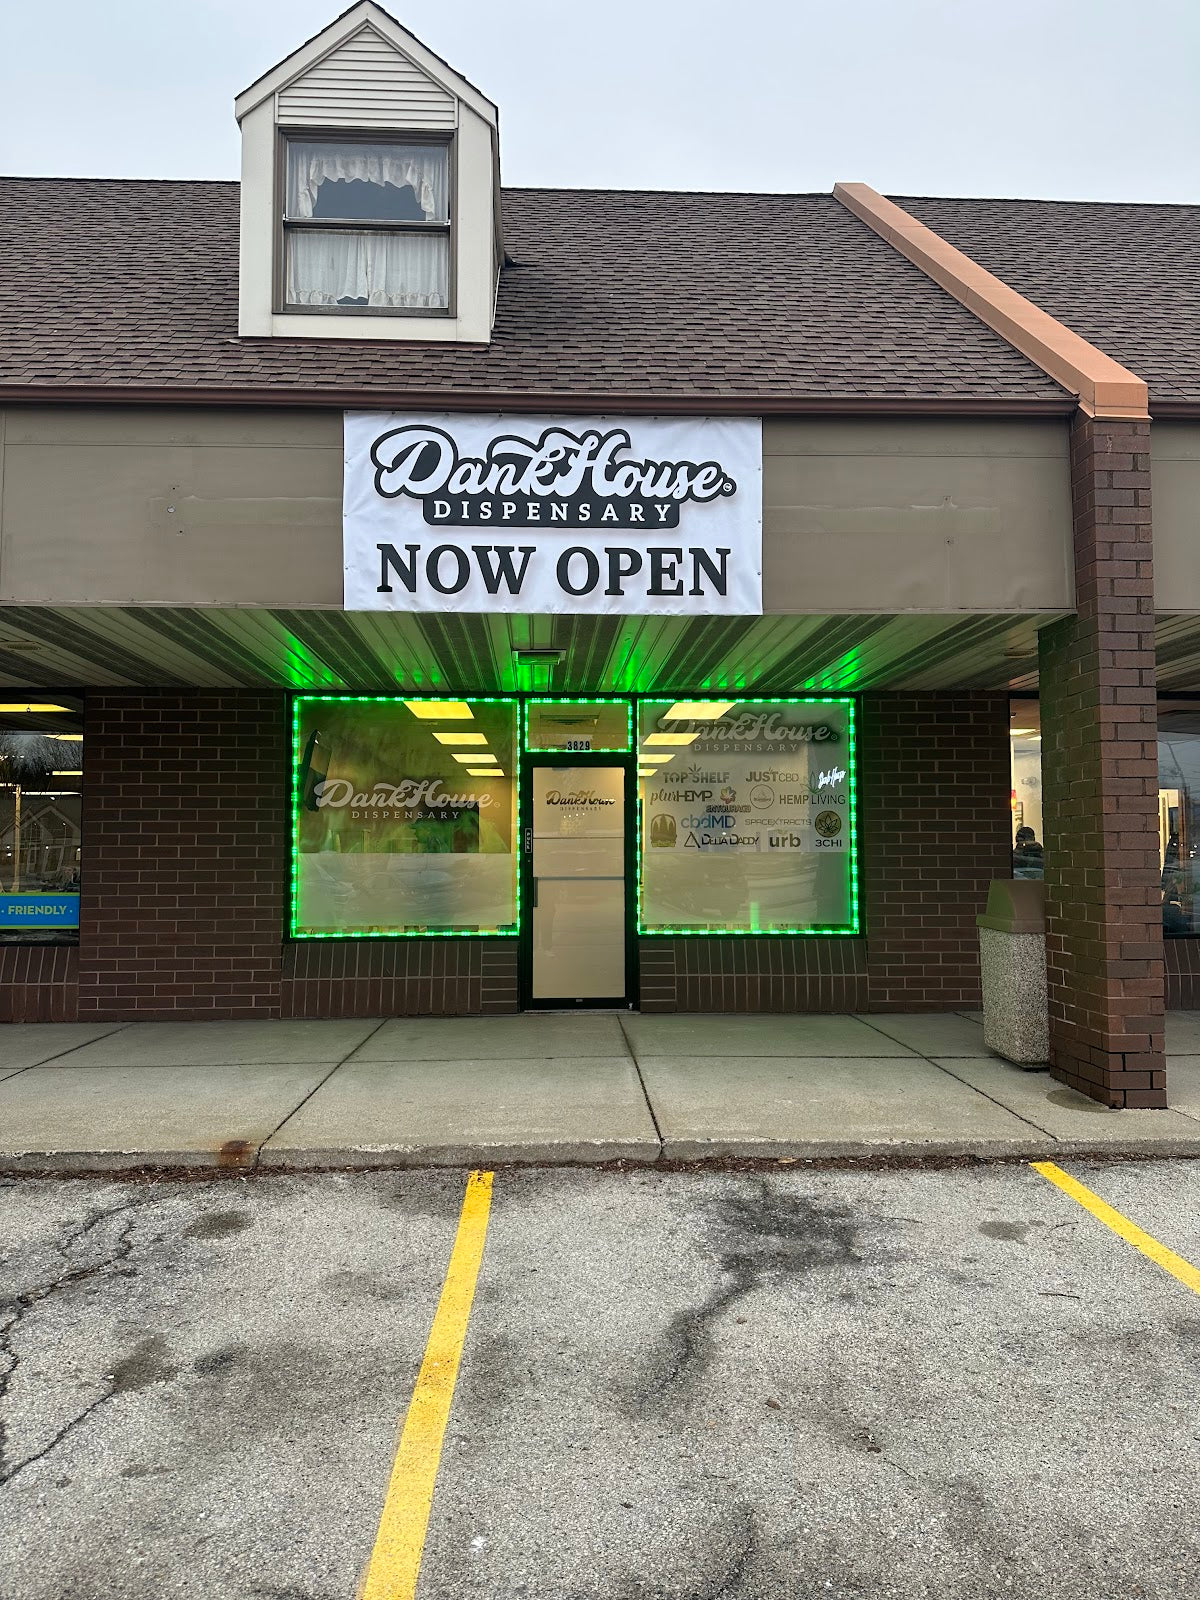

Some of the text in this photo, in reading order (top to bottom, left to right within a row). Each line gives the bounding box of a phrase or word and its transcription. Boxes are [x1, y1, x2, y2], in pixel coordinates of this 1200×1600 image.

[433, 500, 672, 523] DISPENSARY
[376, 543, 731, 597] NOW OPEN
[567, 740, 591, 751] 3829
[694, 743, 799, 752] DISPENSARY
[662, 771, 730, 784] TOP SHELF
[779, 794, 809, 805] HEMP
[811, 794, 846, 805] LIVING
[351, 811, 461, 819] DISPENSARY
[680, 814, 737, 829] cbdMD
[769, 833, 802, 848] urb
[815, 839, 842, 847] 3CHI
[7, 905, 67, 915] FRIENDLY
